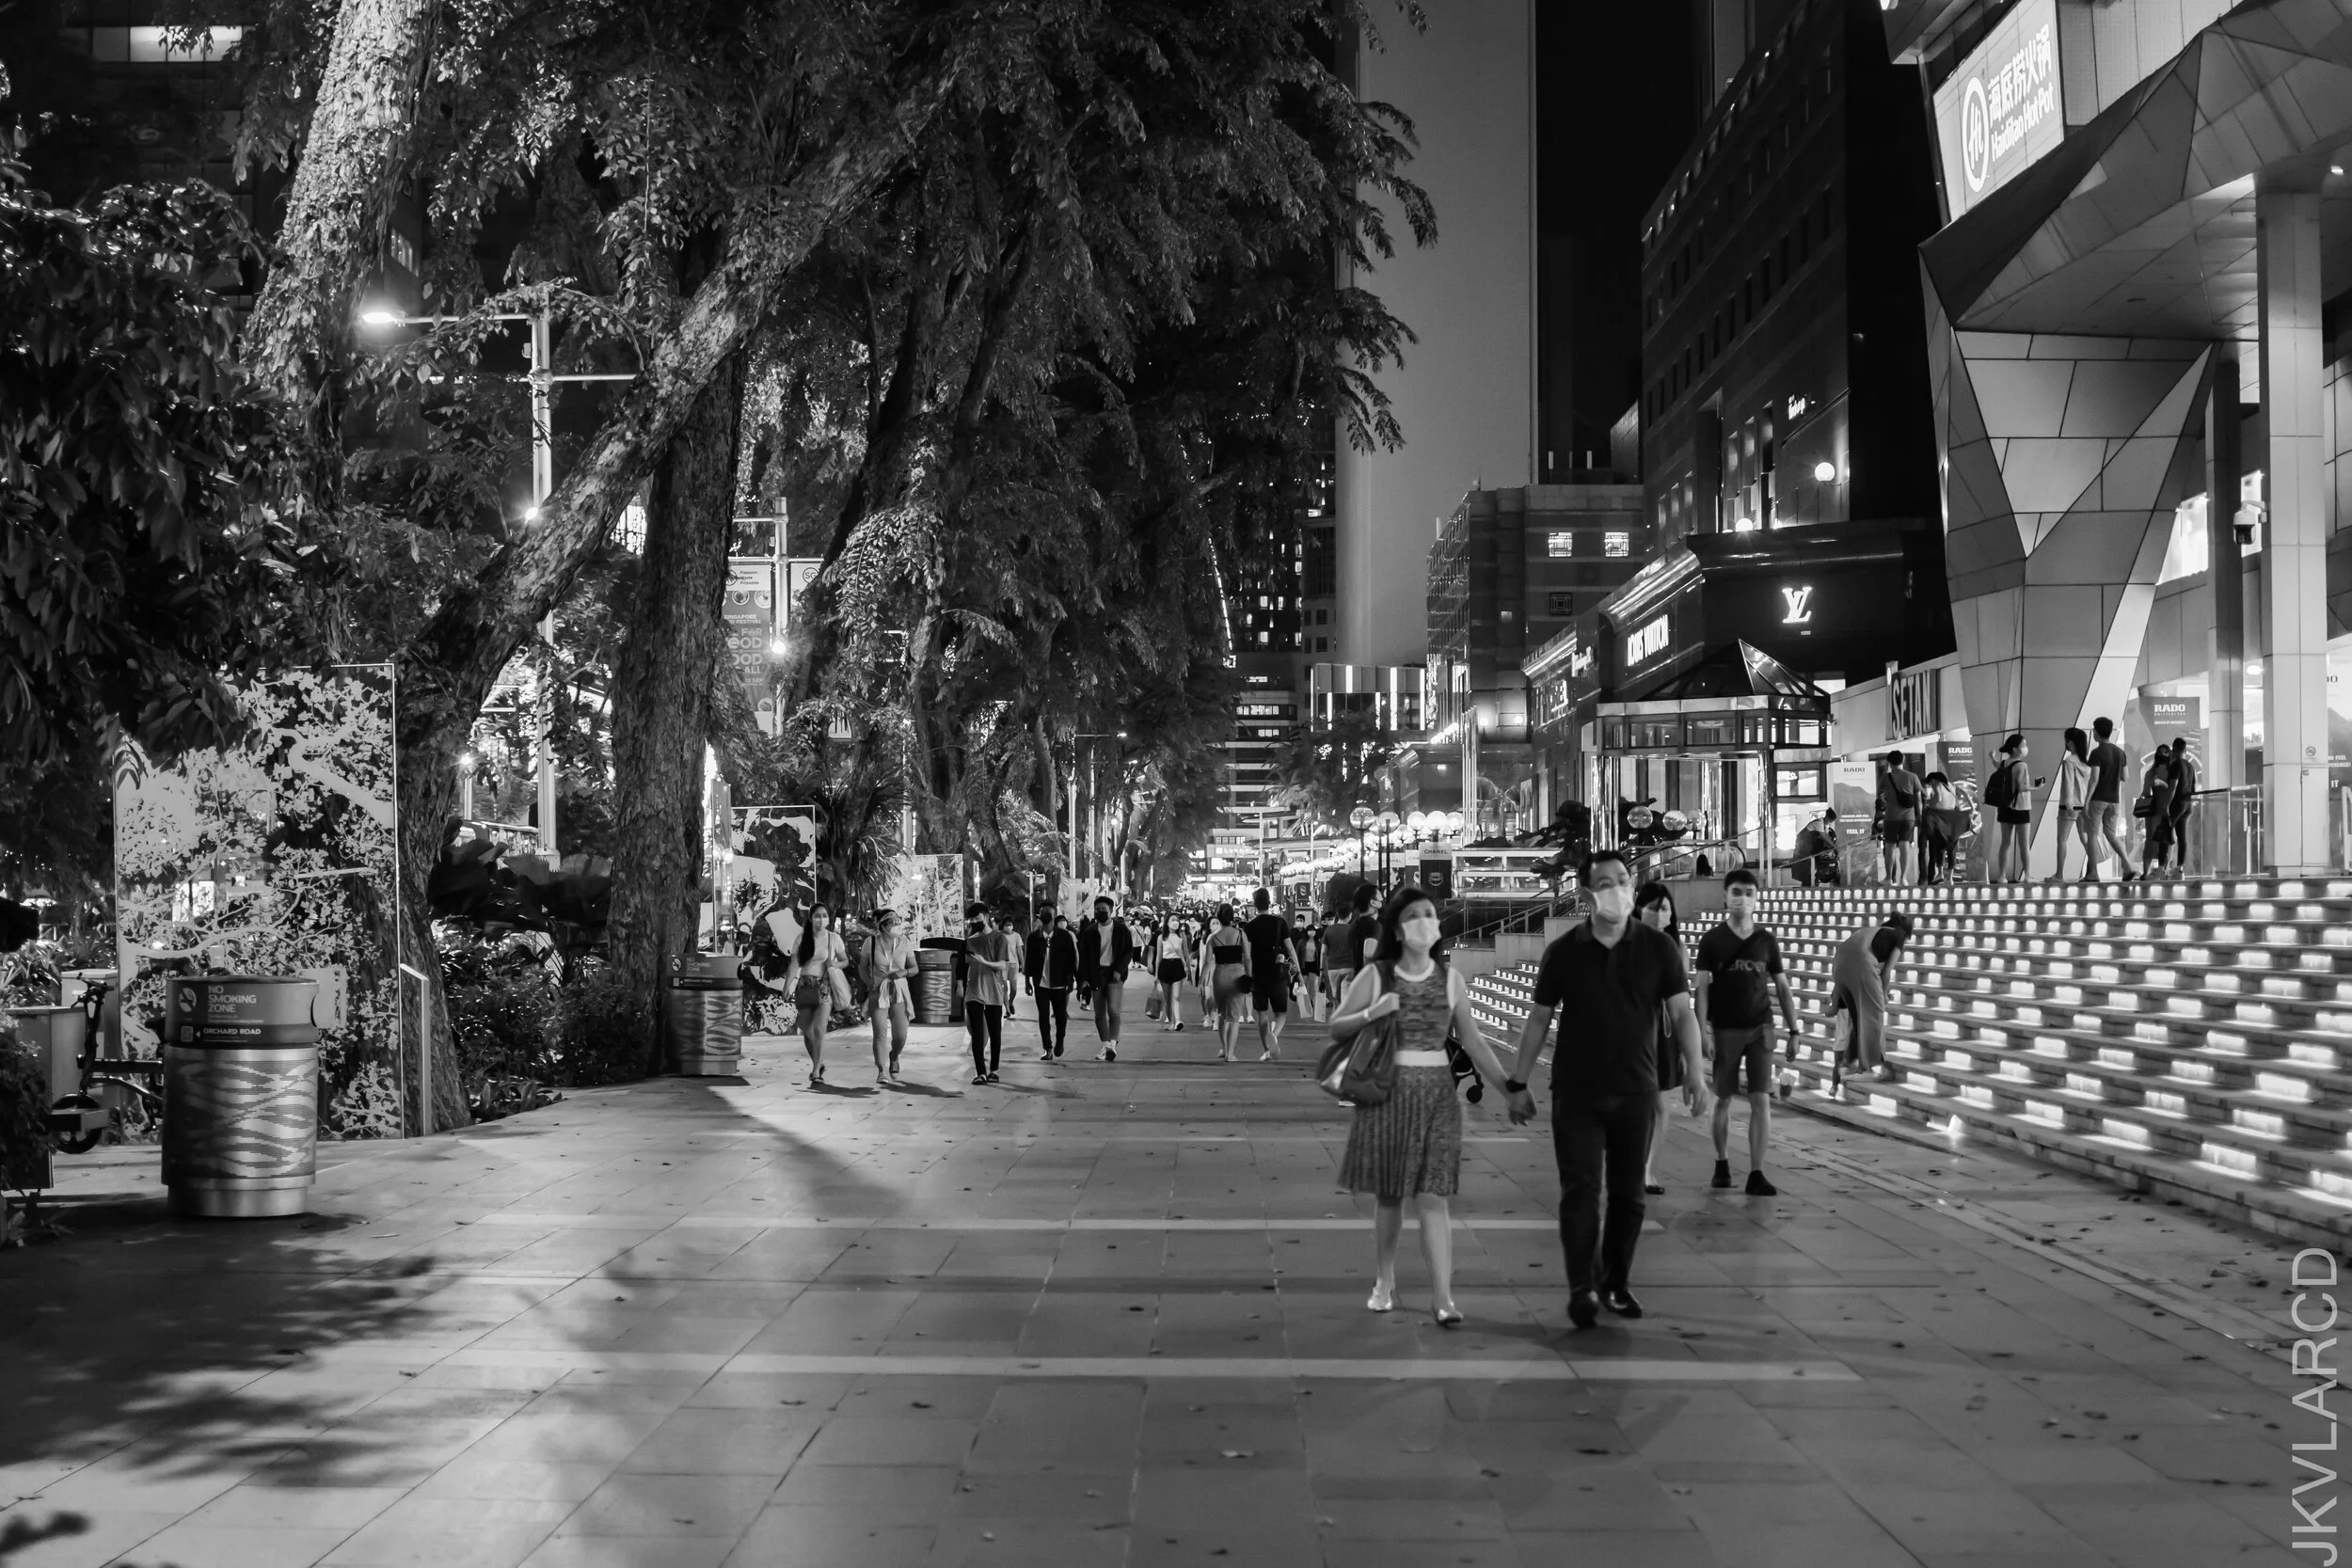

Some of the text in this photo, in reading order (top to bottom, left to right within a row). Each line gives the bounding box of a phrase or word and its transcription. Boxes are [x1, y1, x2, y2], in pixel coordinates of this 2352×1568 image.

[1991, 82, 2054, 162] Haidilao Hot Pot
[726, 636, 763, 649] OOD
[2154, 704, 2186, 712] RADO
[208, 994, 258, 1004] SMOKING
[208, 1004, 236, 1013] ZONE
